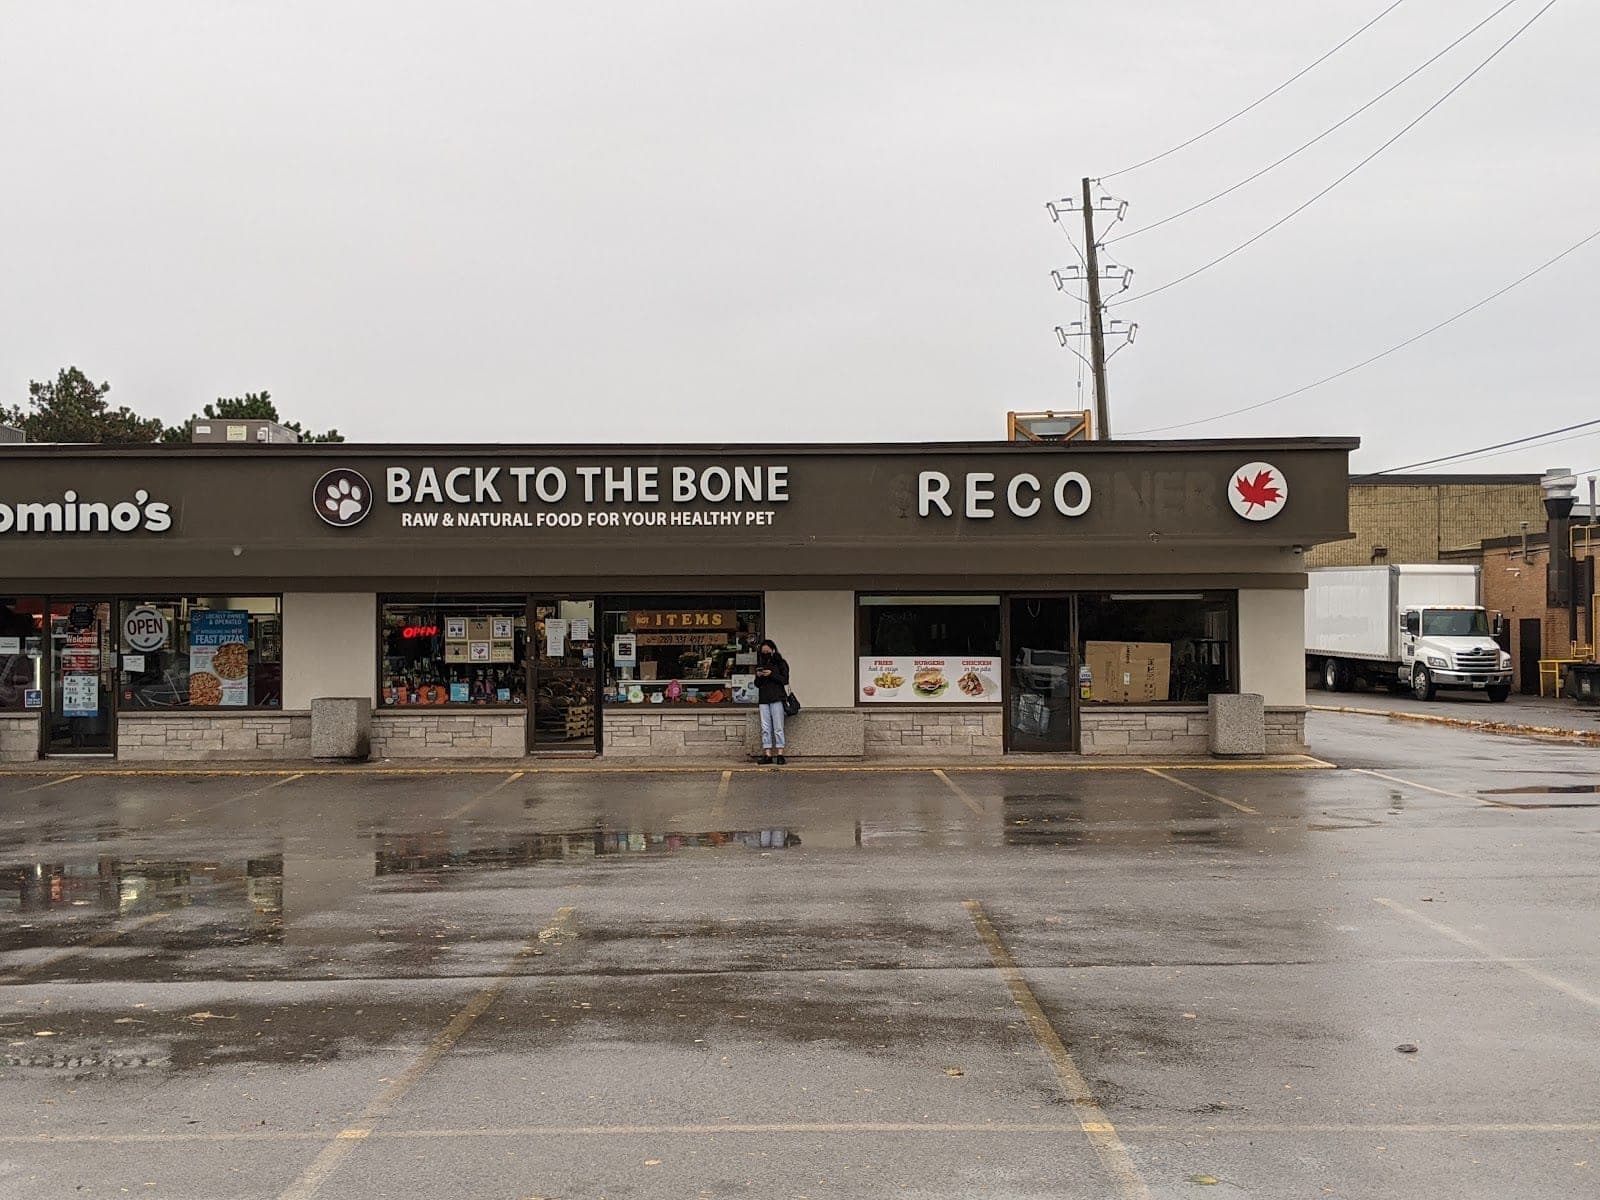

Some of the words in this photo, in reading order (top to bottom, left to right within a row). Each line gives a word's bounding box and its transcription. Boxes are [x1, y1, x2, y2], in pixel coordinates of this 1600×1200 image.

[386, 466, 502, 503] BACK
[509, 466, 567, 503] TO
[576, 466, 659, 502] THE
[672, 466, 789, 502] BONE
[918, 471, 1092, 518] RECO
[401, 512, 439, 527] RAW
[441, 512, 455, 527] &
[457, 512, 533, 527] NATURAL
[536, 512, 583, 527] FOOD
[587, 512, 620, 527] FOR
[621, 511, 667, 526] YOUR
[670, 511, 742, 526] HEALTHY
[745, 511, 775, 525] PET
[655, 613, 722, 626] ITEMS
[127, 618, 164, 636] OPEN
[402, 625, 438, 638] OPEN
[66, 634, 98, 644] Welcome
[195, 634, 217, 644] FEAST
[218, 634, 245, 644] PIZZAS
